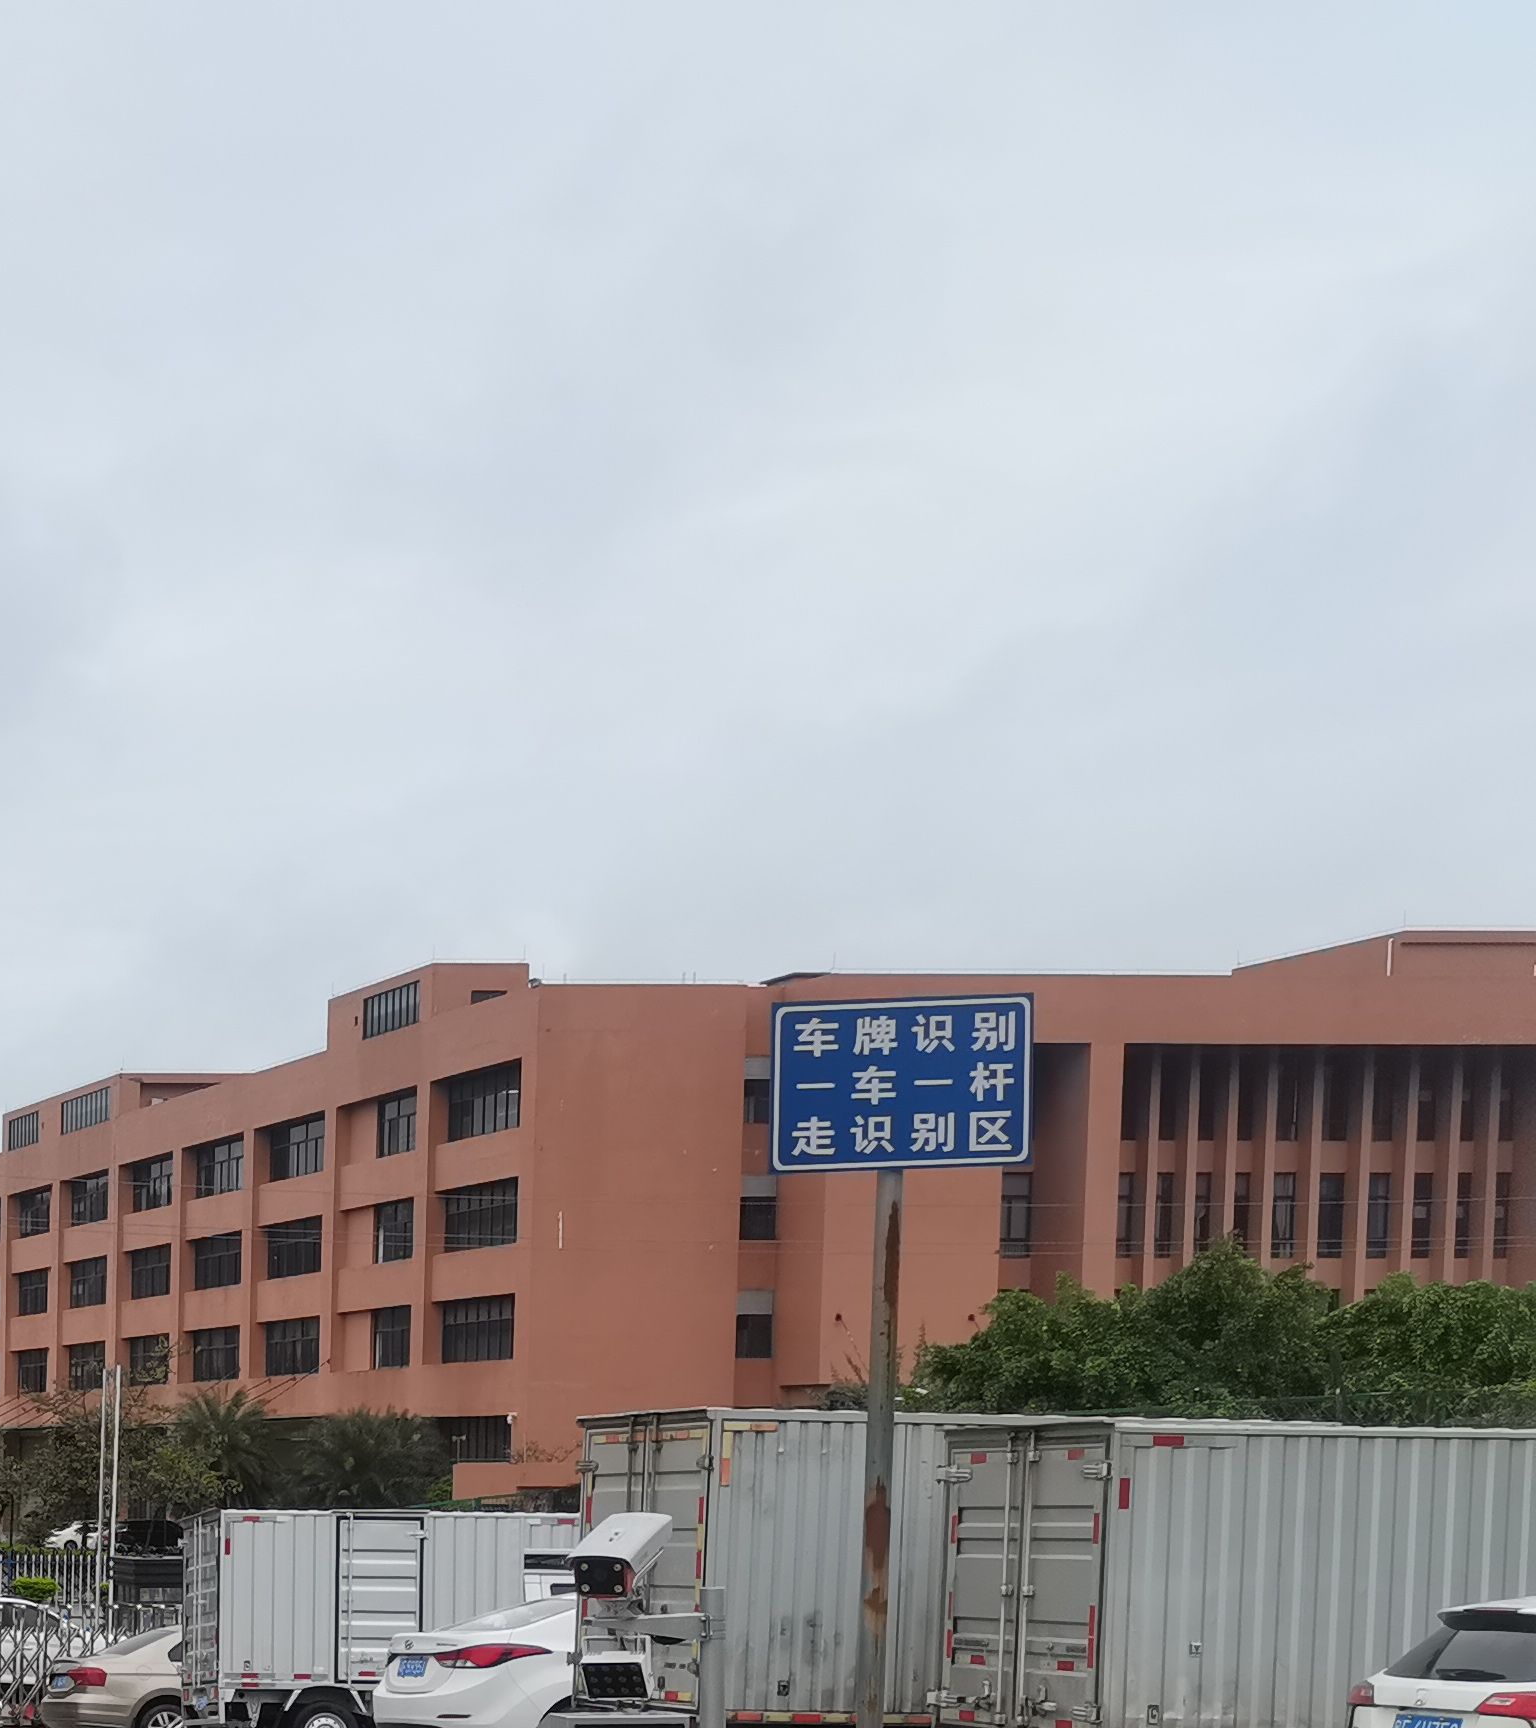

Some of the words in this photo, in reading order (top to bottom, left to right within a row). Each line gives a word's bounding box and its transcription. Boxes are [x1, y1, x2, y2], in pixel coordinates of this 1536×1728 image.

[793, 1010, 1016, 1057] 车牌识别
[795, 1061, 1015, 1105] 一车一杆
[791, 1110, 1013, 1156] 走识别区
